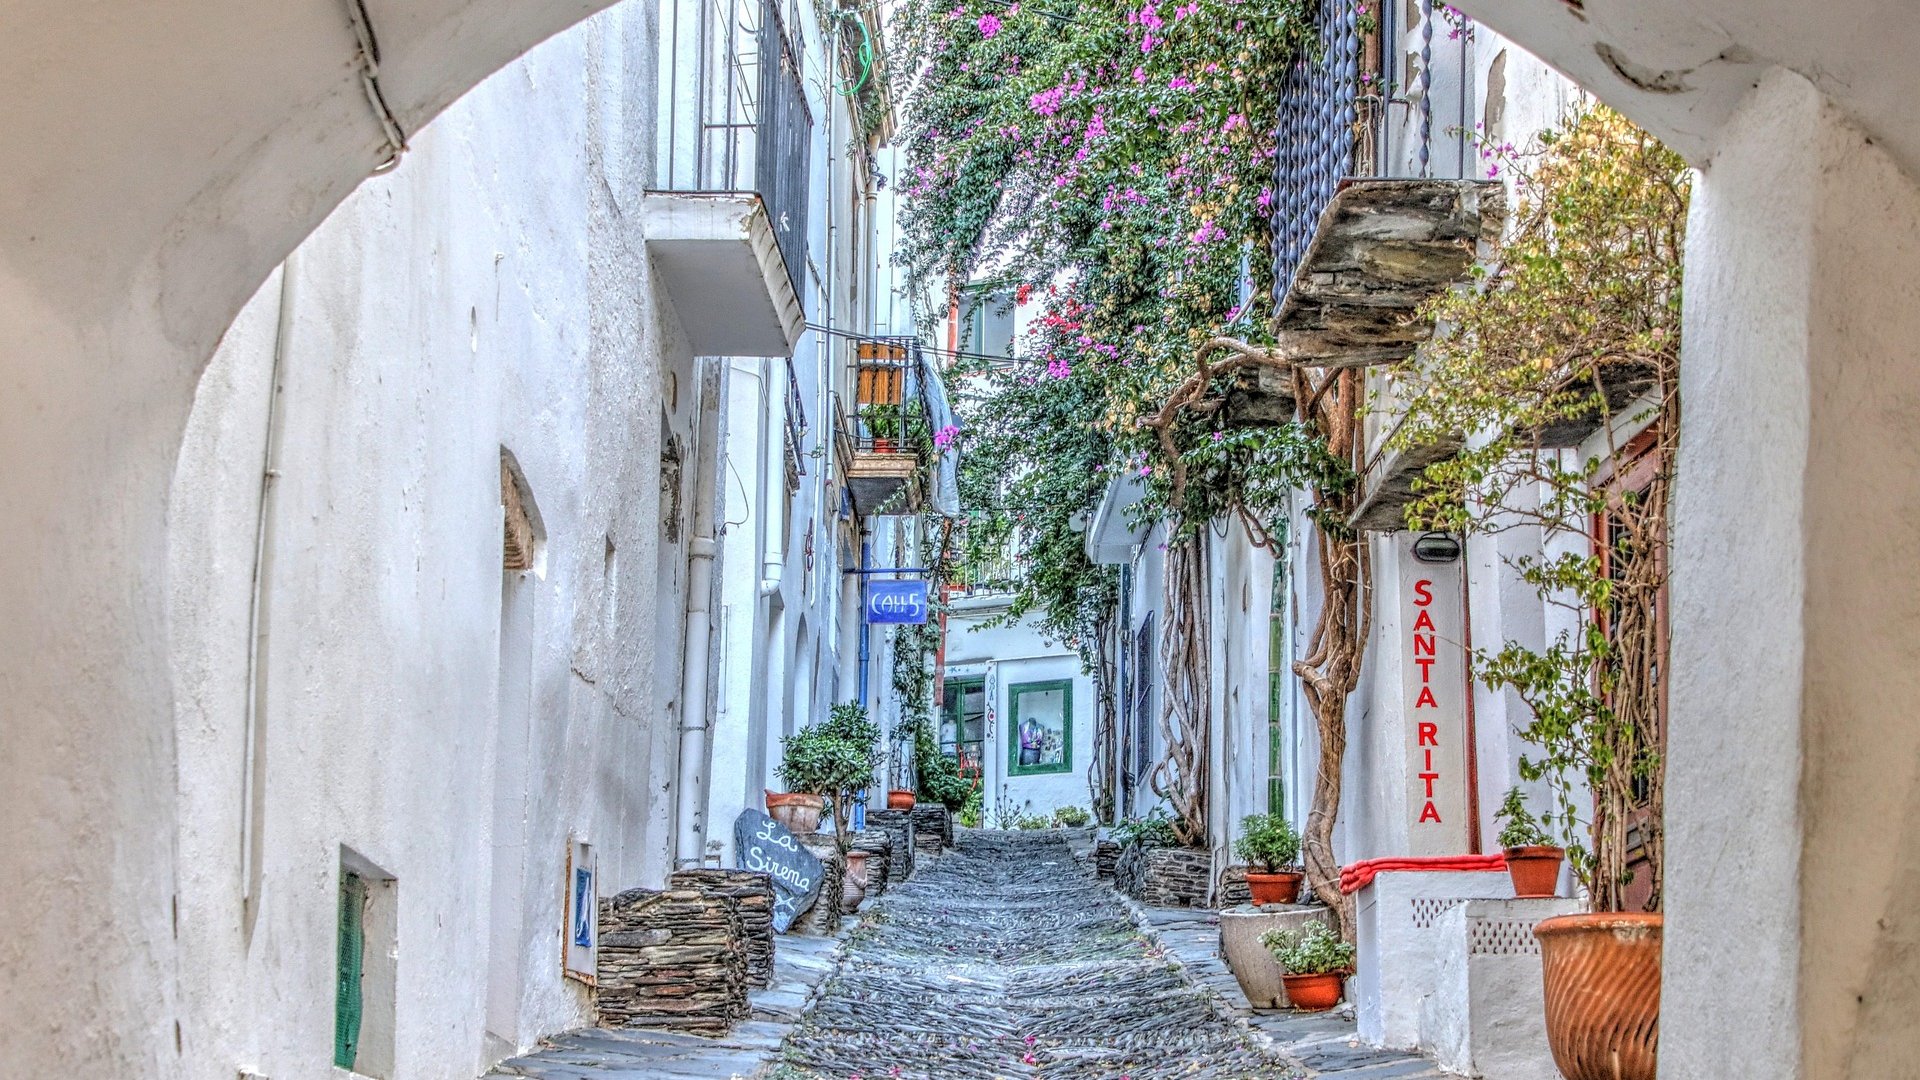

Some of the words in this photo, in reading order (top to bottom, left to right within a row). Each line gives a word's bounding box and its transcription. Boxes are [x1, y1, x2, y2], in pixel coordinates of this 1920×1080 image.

[1413, 579, 1438, 708] SANTA
[1418, 722, 1442, 823] RITA
[746, 846, 810, 892] Sirena
[756, 820, 797, 852] La
